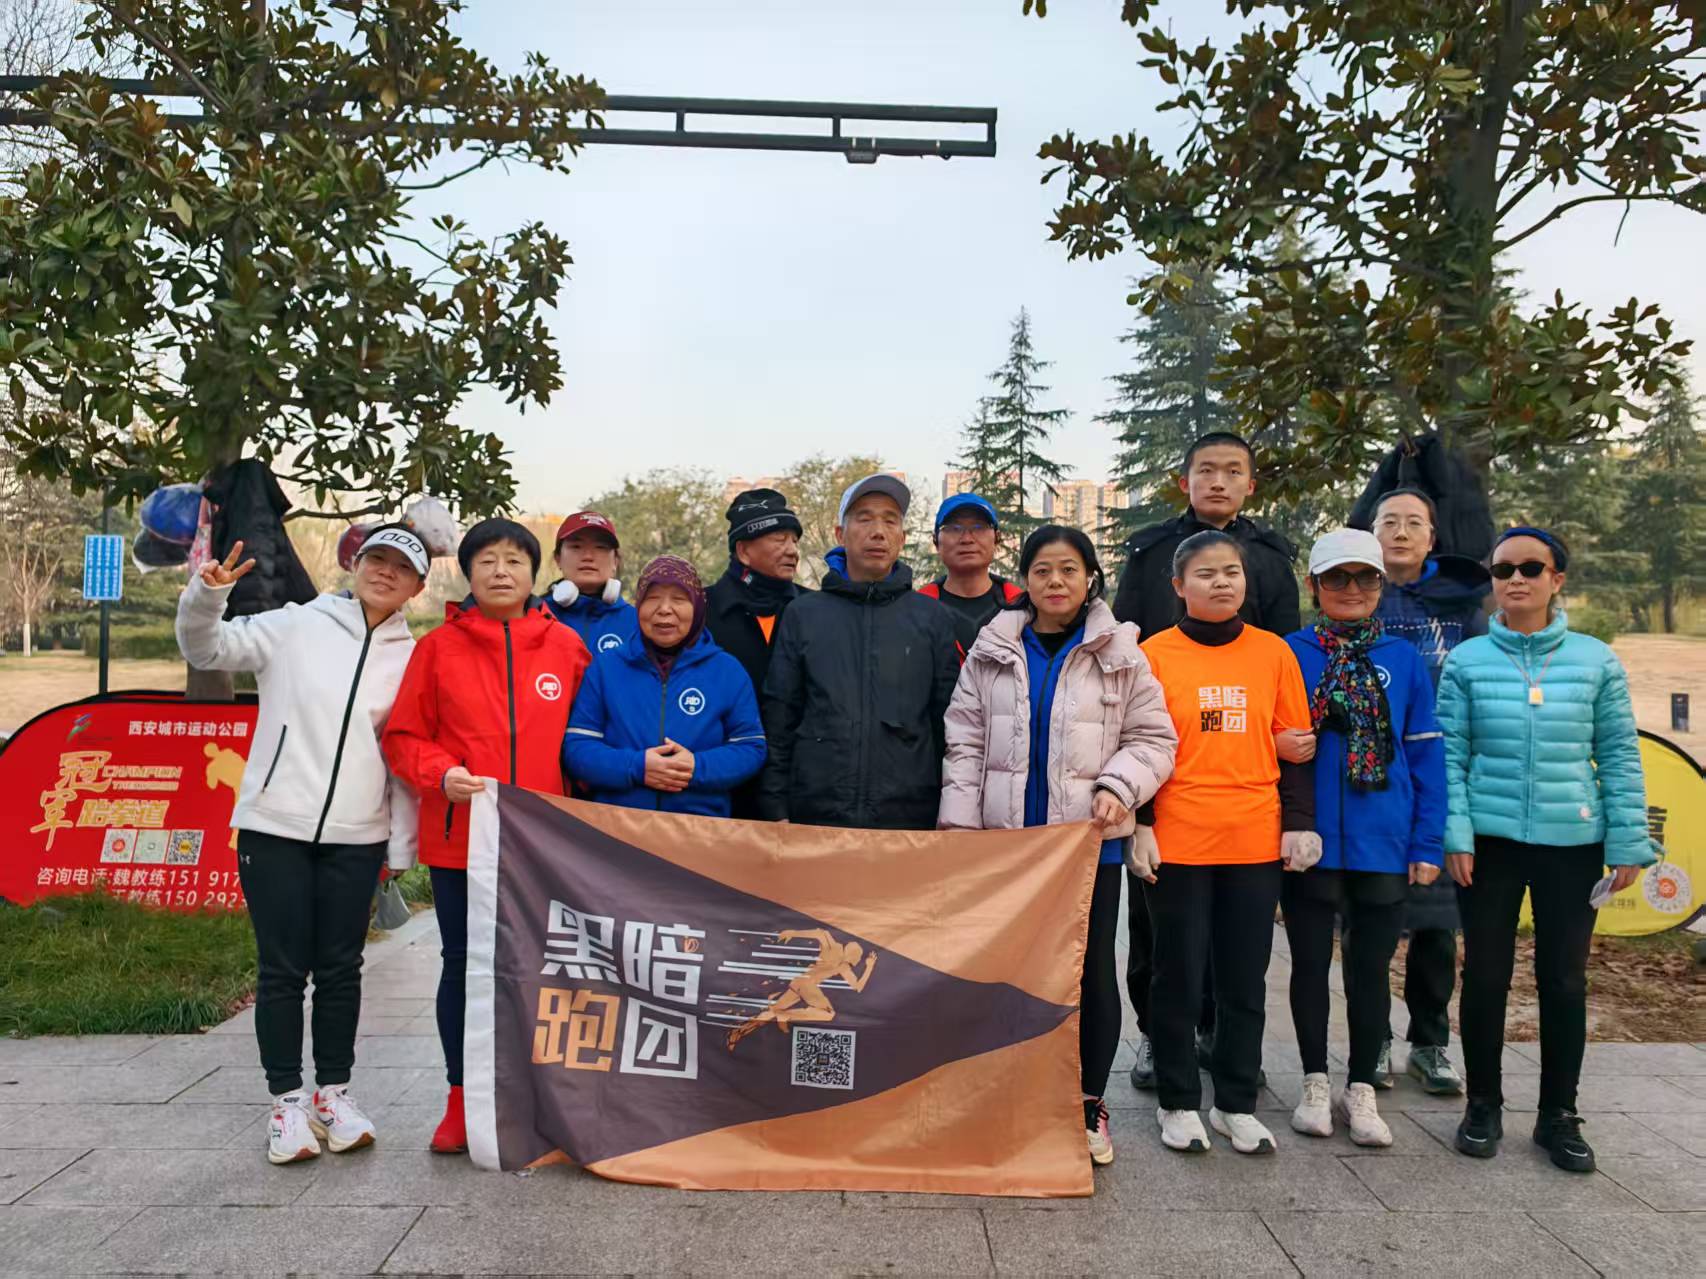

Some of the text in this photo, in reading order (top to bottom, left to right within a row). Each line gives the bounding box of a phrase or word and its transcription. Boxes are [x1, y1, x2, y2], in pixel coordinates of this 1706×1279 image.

[1198, 685, 1248, 709] 黑暗
[128, 720, 249, 737] 西安城市运动公园
[1200, 709, 1247, 733] 跑团
[540, 899, 707, 1006] 黑暗
[531, 986, 699, 1080] 跑团
